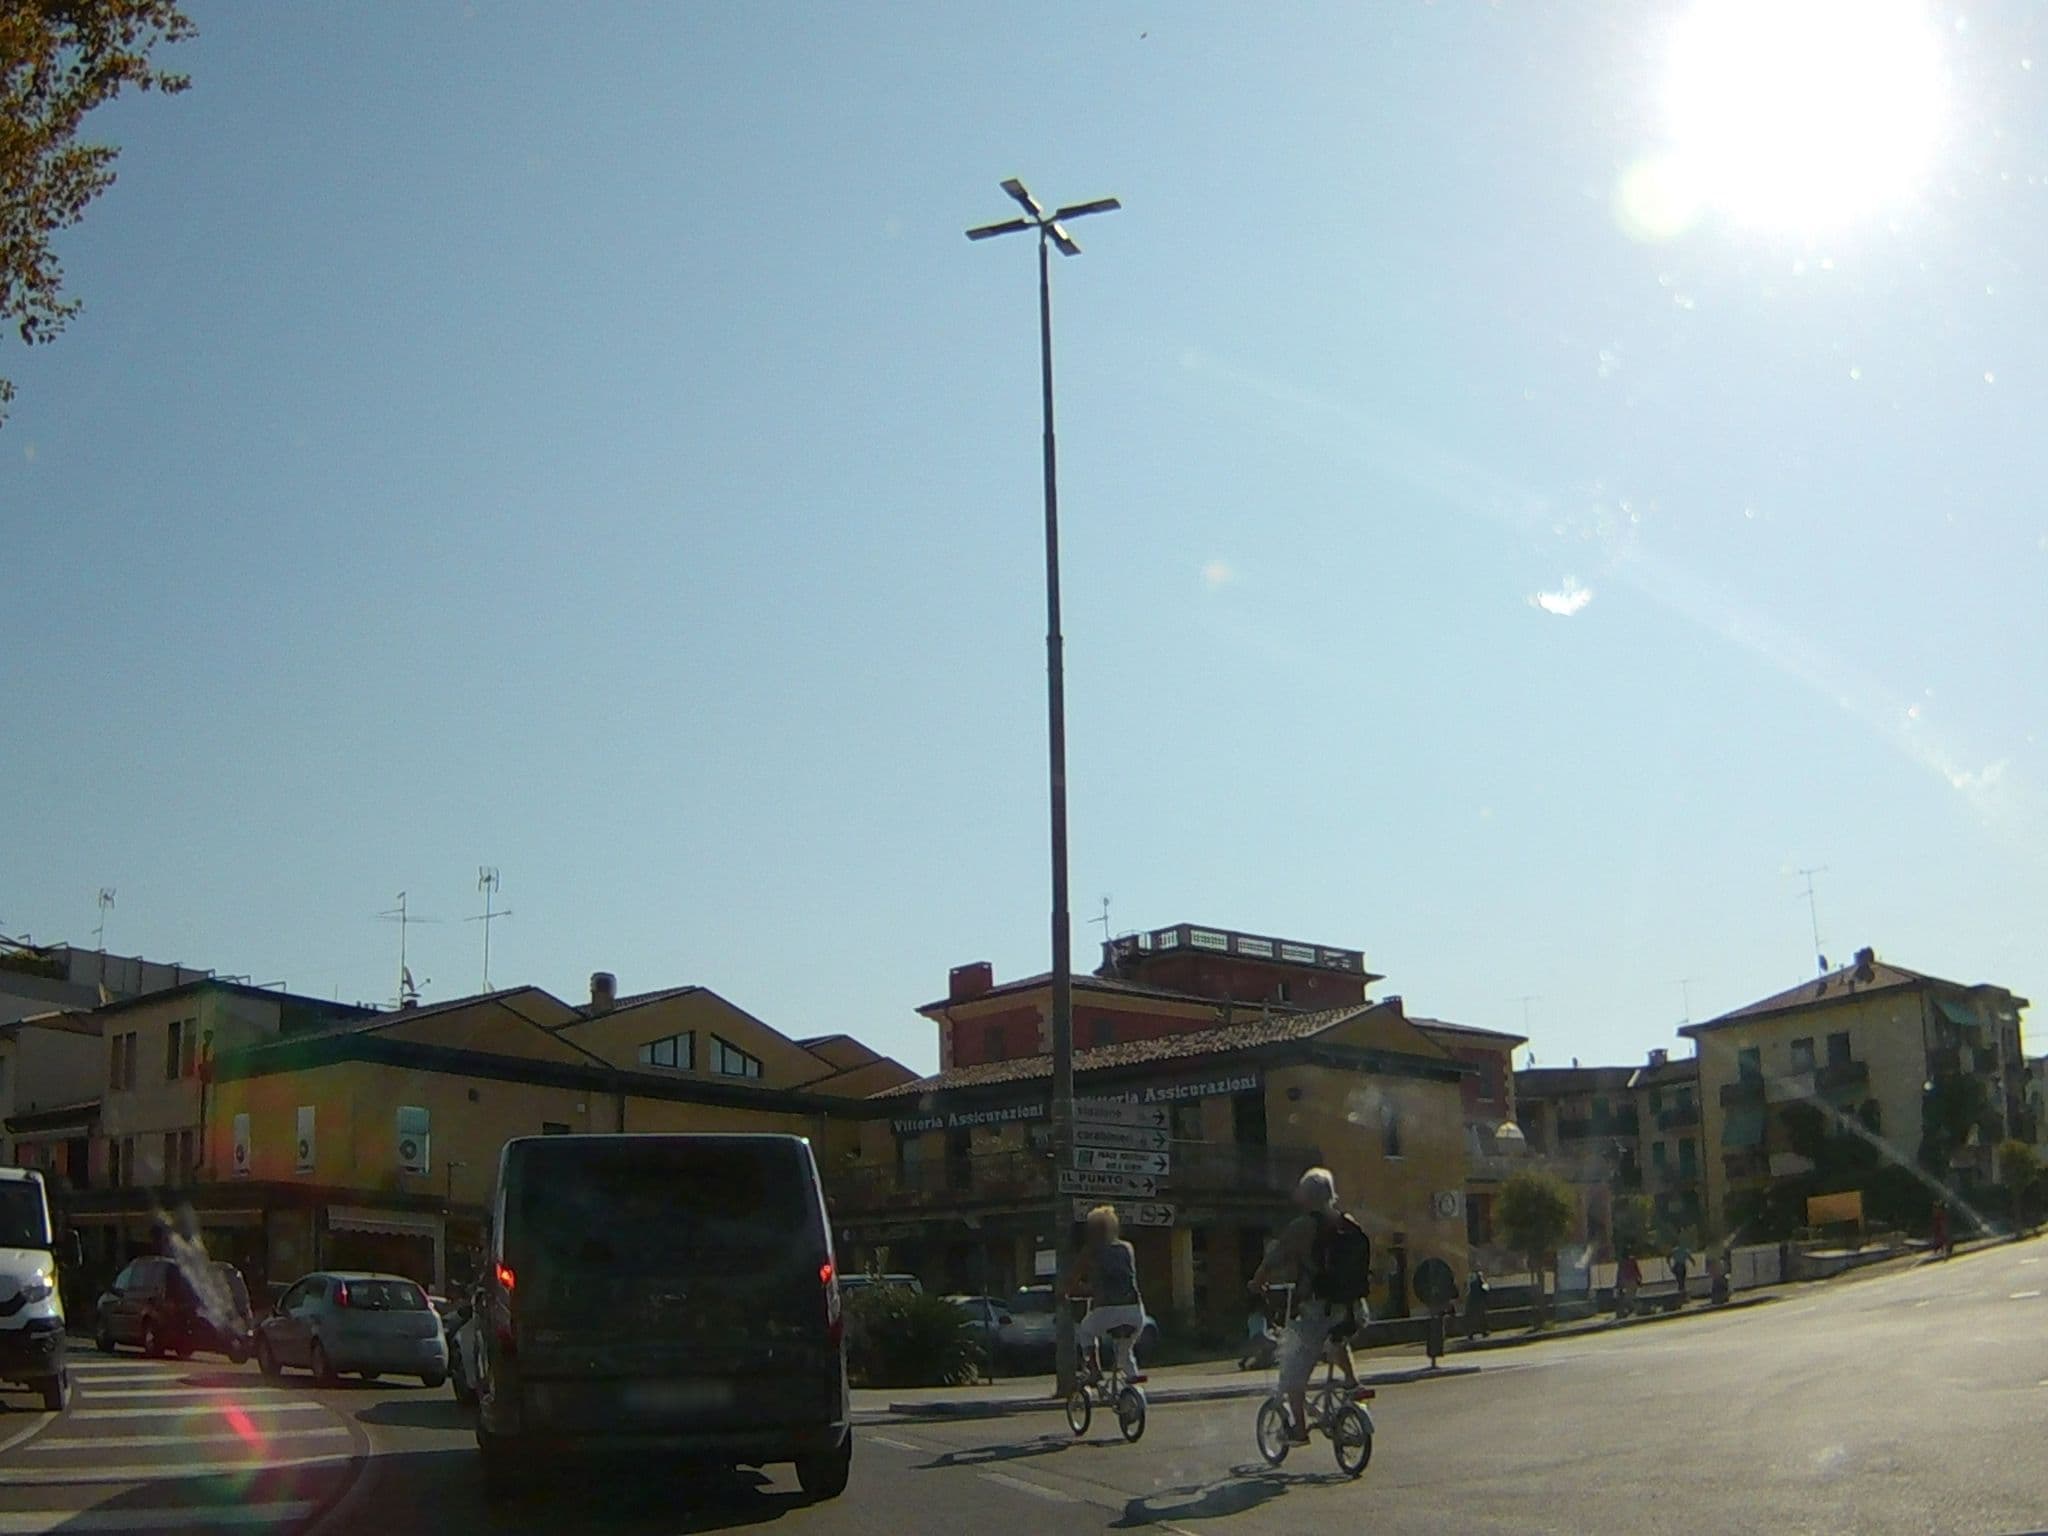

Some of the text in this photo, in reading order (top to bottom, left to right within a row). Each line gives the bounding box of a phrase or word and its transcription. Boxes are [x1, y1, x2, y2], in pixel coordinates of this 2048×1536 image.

[1144, 1073, 1257, 1103] Assicurazioni
[894, 1103, 1044, 1133] Vittoria Assicurazioni
[1062, 1172, 1123, 1185] IL PUNTO
